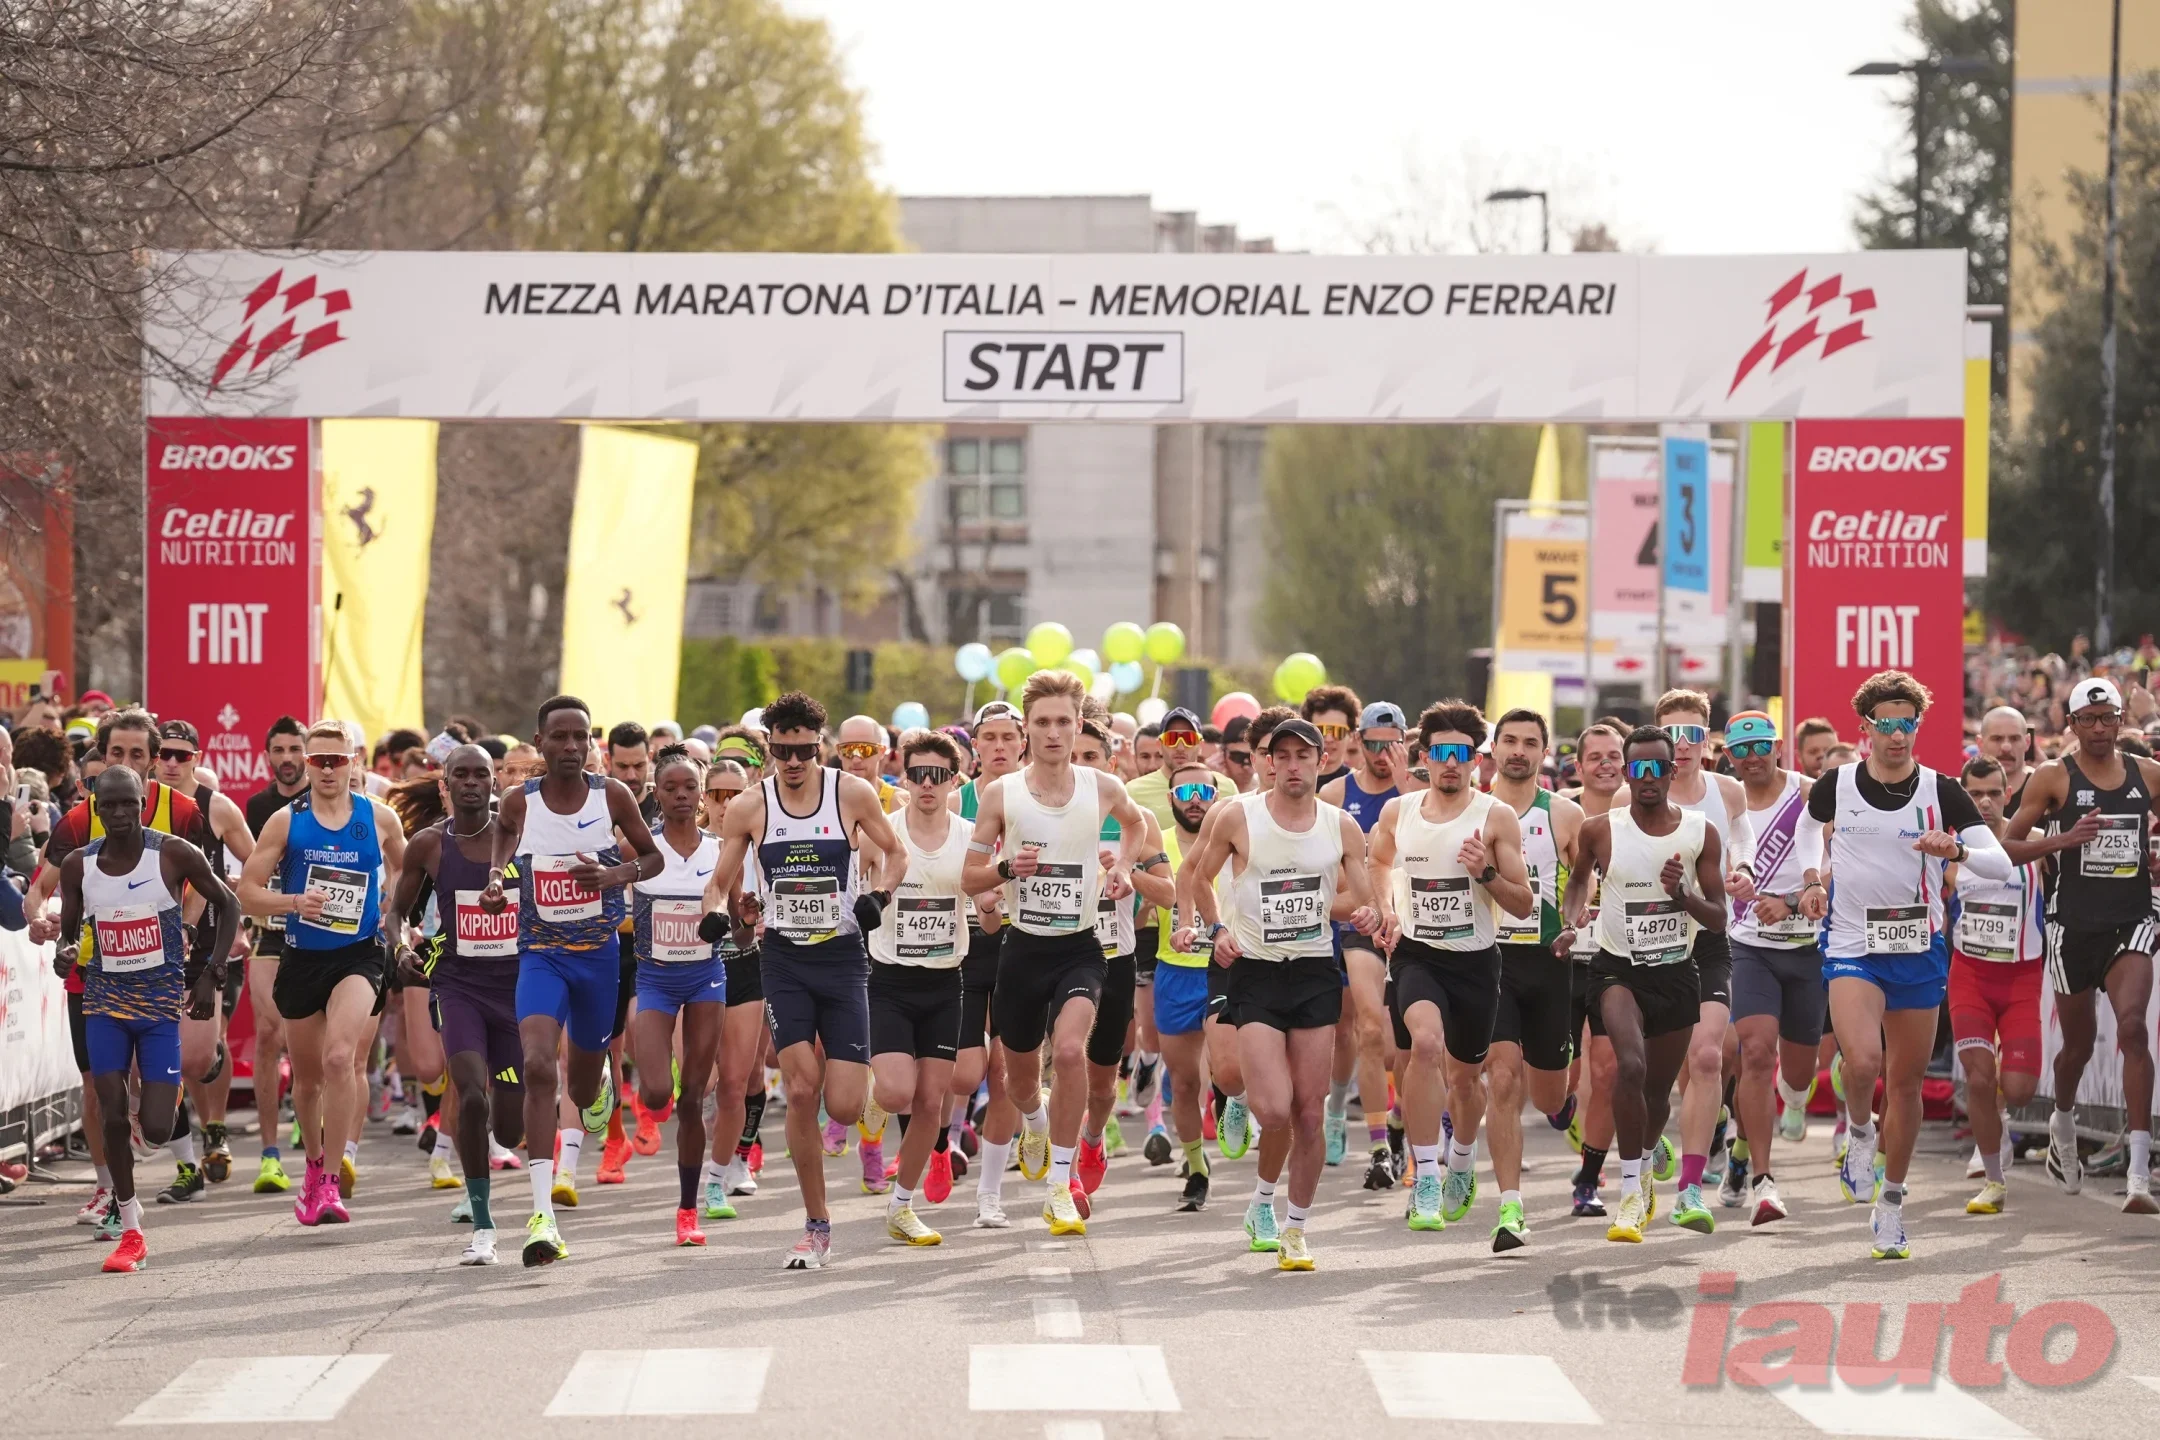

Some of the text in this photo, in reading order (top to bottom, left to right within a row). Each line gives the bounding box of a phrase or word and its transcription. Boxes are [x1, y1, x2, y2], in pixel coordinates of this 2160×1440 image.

[485, 284, 620, 315] MEZZA
[634, 284, 869, 315] MARATONA
[883, 284, 1044, 315] D'ITALIA
[1090, 284, 1310, 315] MEMORIAL
[1323, 284, 1432, 315] ENZO
[1446, 284, 1616, 315] FERRARI
[964, 343, 1164, 391] START
[160, 445, 297, 470] BROOKS
[1808, 445, 1951, 472] BROOKS
[161, 508, 293, 538] Cetilar
[1679, 484, 1695, 555] 3
[1809, 510, 1946, 541] Cetilar
[160, 541, 295, 566] NUTRITION
[1808, 543, 1948, 569] NUTRITION
[1543, 573, 1577, 625] 5
[188, 603, 269, 664] FIAT
[1836, 606, 1920, 668] FIAT
[207, 733, 252, 750] ACQUA
[200, 752, 270, 781] ANNA
[2096, 835, 2129, 848] 7253
[304, 849, 359, 863] SEMPREDICORSA
[785, 855, 819, 863] MdS
[2085, 864, 2115, 872] BROOKS
[1031, 882, 1071, 898] 4875
[323, 903, 344, 914] ANDREA
[789, 900, 825, 913] 3461
[1040, 900, 1061, 910] THOMAS
[1275, 896, 1313, 914] 4979
[1421, 896, 1460, 911] 4872
[553, 907, 584, 916] BROOKS
[1022, 913, 1051, 923] BROOKS
[1431, 914, 1451, 924] AMORIN
[460, 911, 517, 937] KIPRUTO
[908, 916, 946, 930] 4874
[1283, 915, 1308, 925] GIUSEPPE
[1638, 918, 1677, 935] 4870
[1972, 919, 2004, 933] 1799
[100, 925, 158, 953] KIPLANGAT
[918, 932, 936, 941] MATTIA
[1267, 931, 1297, 940] BROOKS
[1416, 928, 1444, 937] BROOKS
[1760, 932, 1789, 941] BROOKS
[1878, 925, 1917, 941] 5005
[1889, 942, 1909, 952] PATRICK
[1964, 945, 1988, 954] BROOKS
[116, 957, 147, 966] BROOKS
